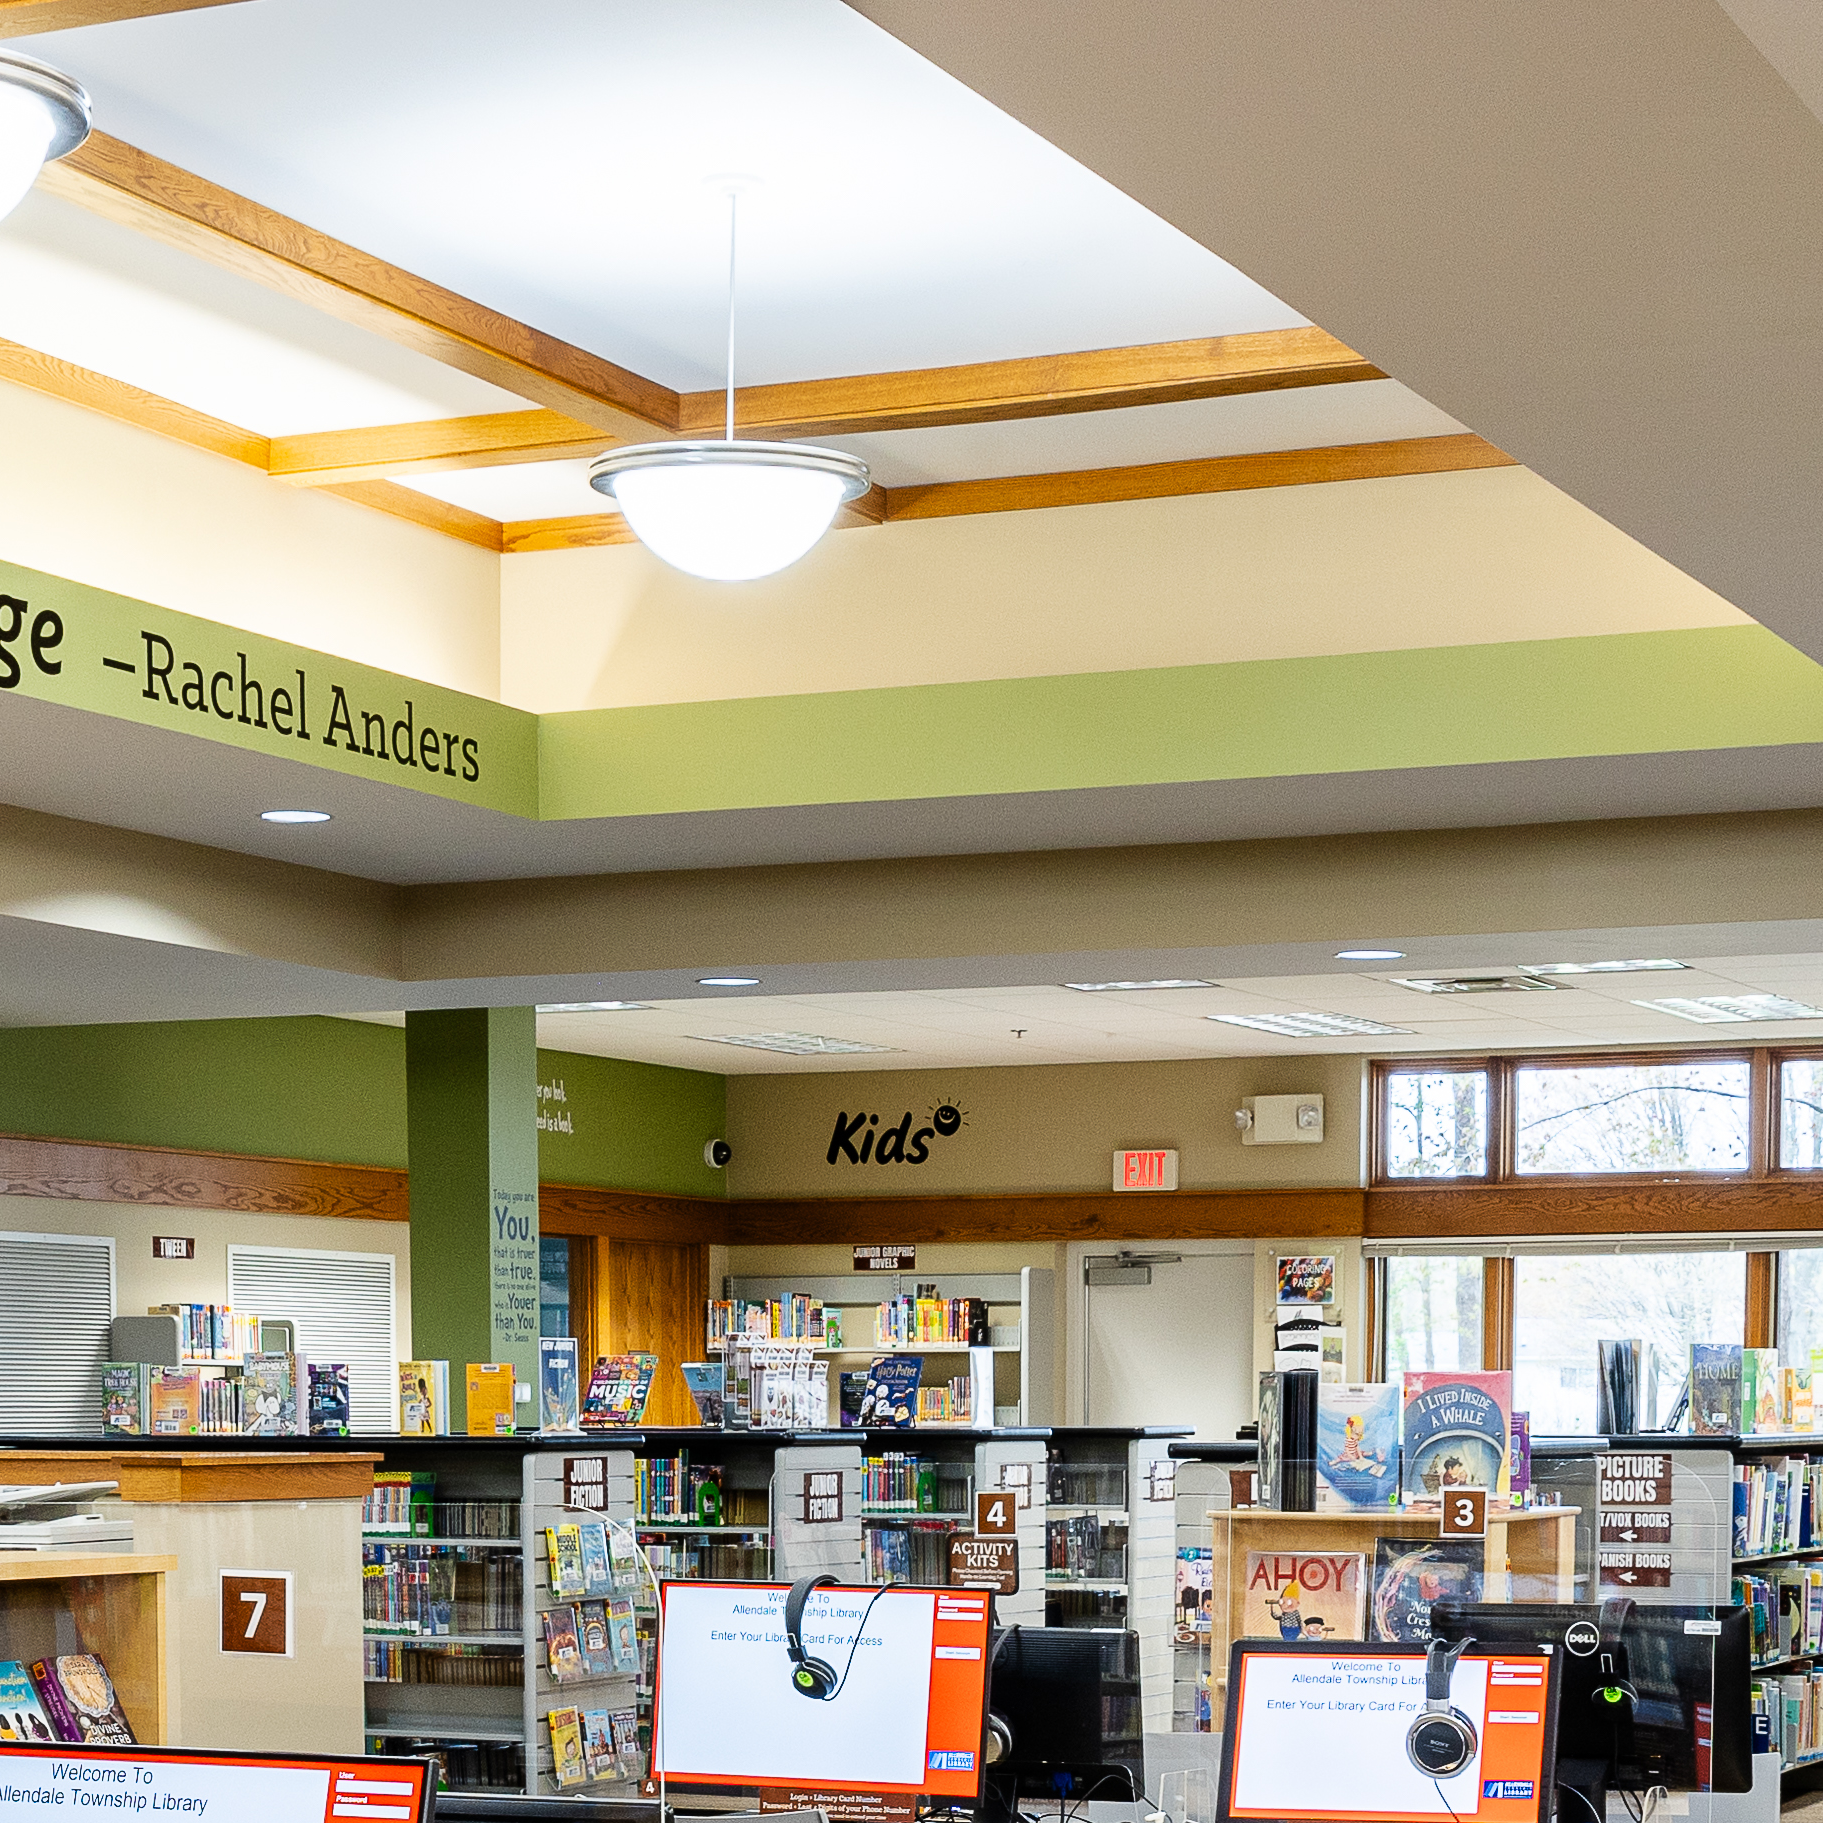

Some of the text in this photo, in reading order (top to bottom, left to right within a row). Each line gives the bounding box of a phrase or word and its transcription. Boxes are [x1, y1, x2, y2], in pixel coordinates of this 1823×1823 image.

[323, 683, 481, 784] Anders
[826, 1111, 935, 1165] Kids
[1124, 1151, 1166, 1188] EXIT
[495, 1205, 535, 1244] You,
[854, 1246, 915, 1258] JUNIOR GRAPHIC
[495, 1262, 535, 1280] than true.
[870, 1258, 898, 1268] NOVELS
[1286, 1264, 1326, 1276] COLORING
[1292, 1277, 1320, 1288] PAGES
[508, 1293, 535, 1310] Youer
[495, 1314, 537, 1330] than You.
[112, 1369, 130, 1379] MAGIC
[248, 1362, 290, 1372] BABYMOUSE
[1698, 1362, 1739, 1379] HOME
[589, 1385, 646, 1398] MUSIC
[1431, 1407, 1485, 1428] A WHALE
[570, 1460, 603, 1483] JUNIOR
[1599, 1456, 1664, 1479] PICTURE
[810, 1473, 838, 1495] JUNIOR
[1602, 1480, 1657, 1502] BOOKS
[570, 1486, 604, 1508] FICTION
[810, 1499, 838, 1521] FICTION
[986, 1501, 1007, 1527] 4
[1454, 1499, 1474, 1526] 3
[952, 1542, 1013, 1555] ACTIVITY
[967, 1555, 999, 1567] KITS
[1249, 1557, 1354, 1593] AHOY
[239, 1592, 267, 1639] 7
[1569, 1634, 1596, 1643] DELL
[1267, 1699, 1417, 1713] Enter Your Library Card For
[90, 1722, 122, 1736] DIVINE
[51, 1764, 153, 1785] Welcome To
[71, 1788, 148, 1813] Township
[152, 1792, 208, 1817] Library
